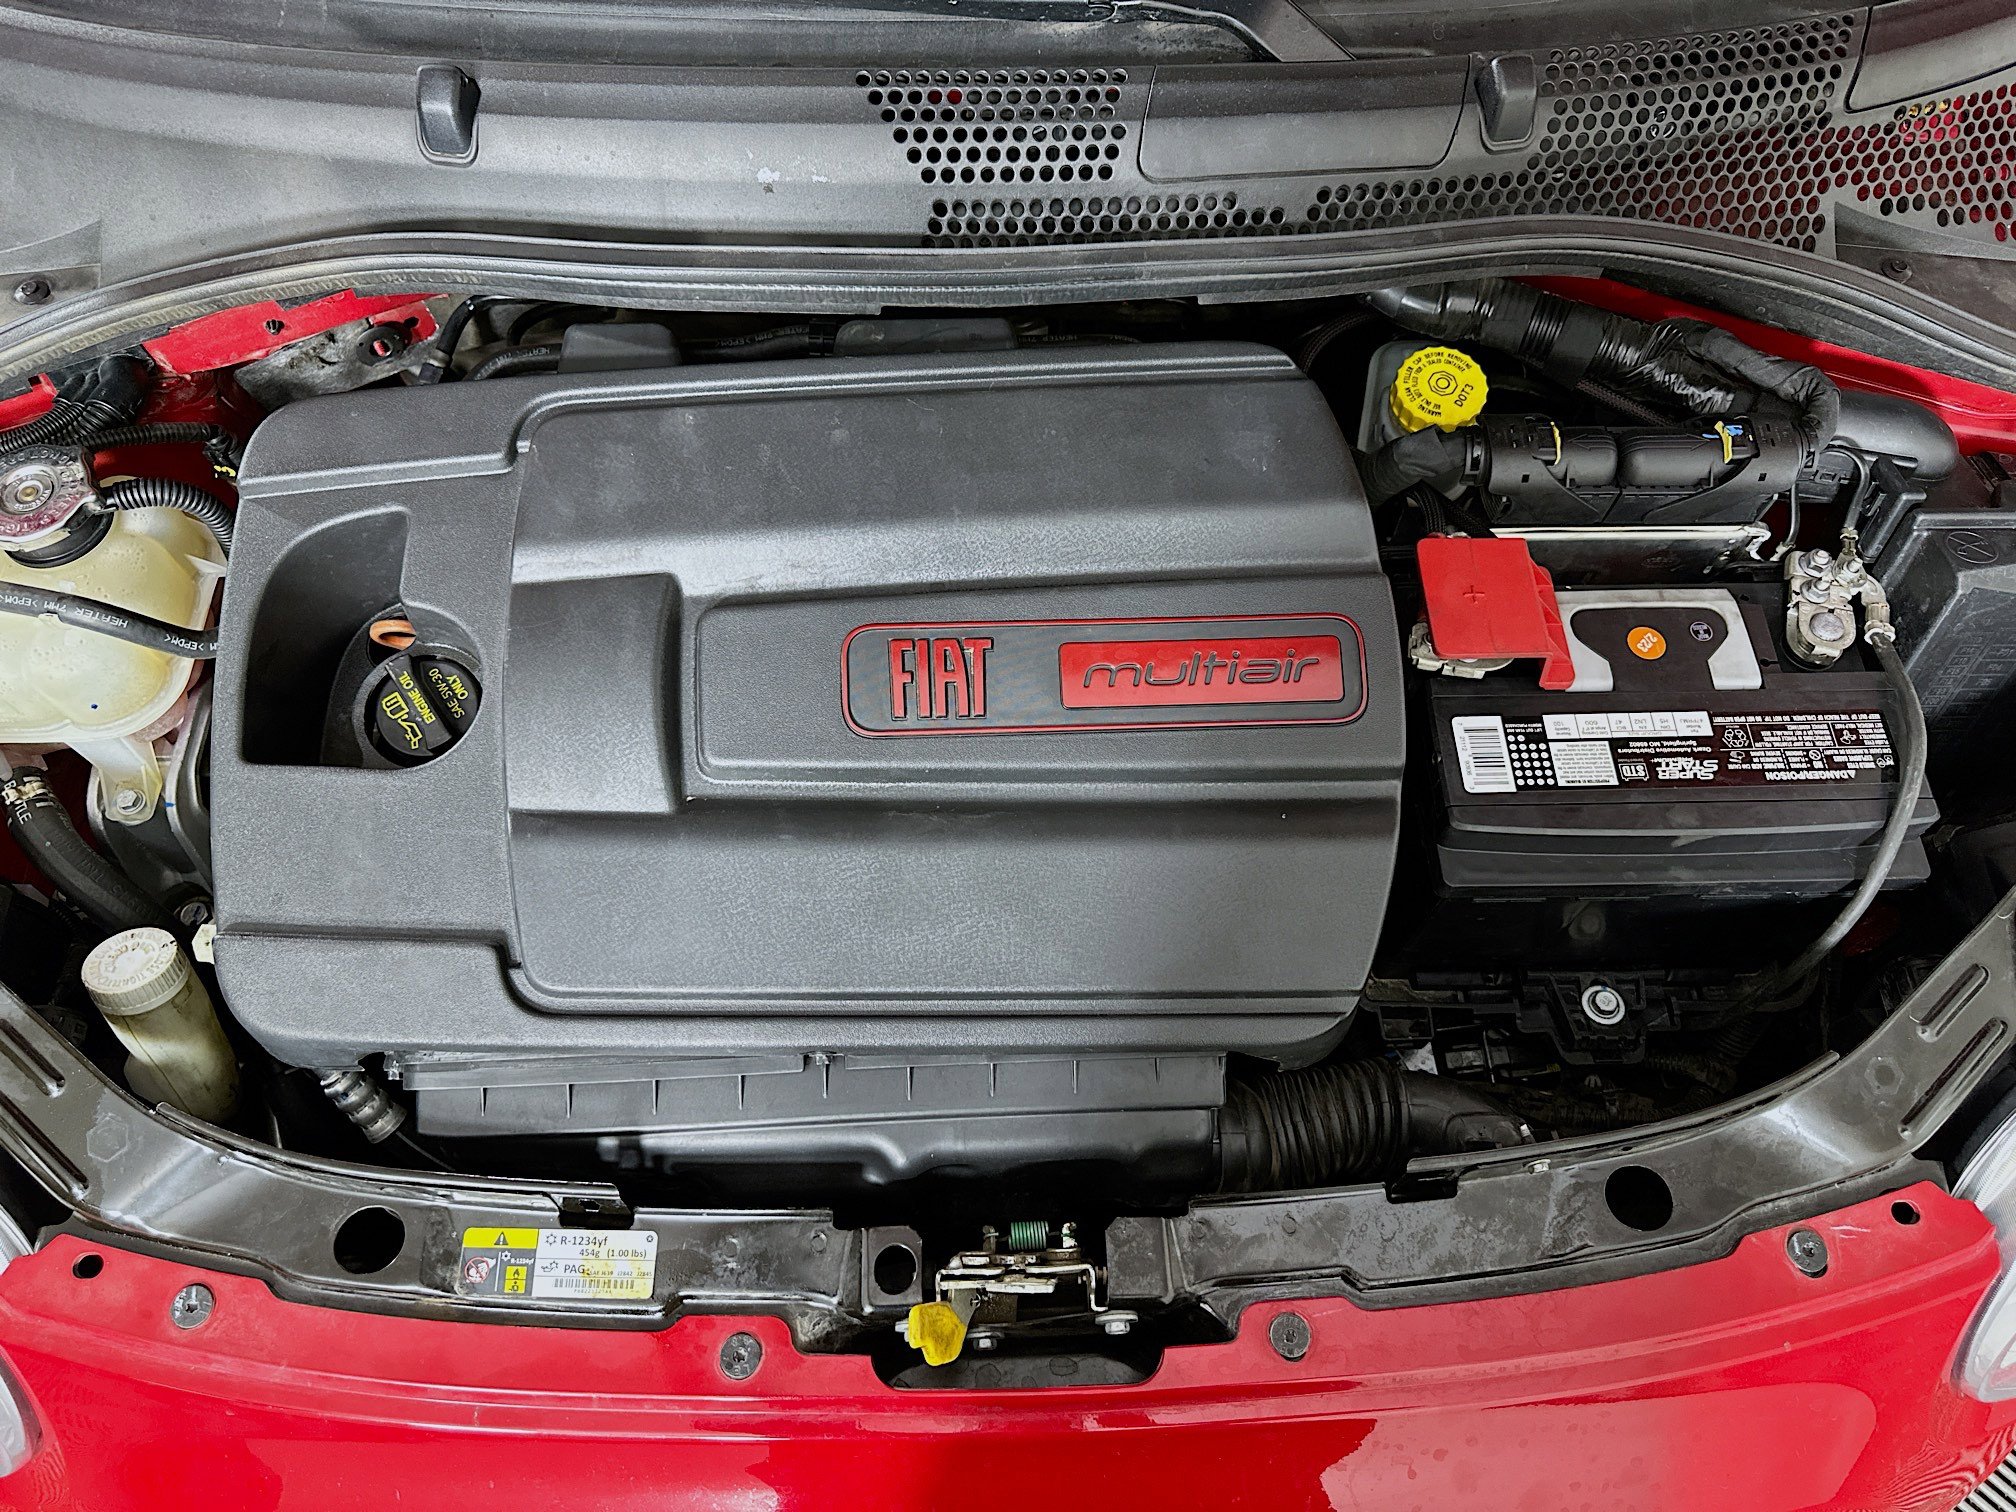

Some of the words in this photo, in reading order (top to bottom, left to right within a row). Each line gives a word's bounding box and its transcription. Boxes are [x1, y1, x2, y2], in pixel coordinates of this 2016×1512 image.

[1448, 353, 1472, 369] REMOVING
[1404, 367, 1413, 383] FILLER
[1405, 387, 1416, 402] CLEAN
[75, 606, 129, 629] HEATER
[1636, 632, 1658, 653] 2/23
[1083, 649, 1319, 689] multiair
[398, 671, 414, 690] OIL
[428, 667, 453, 700] 5W-30
[889, 637, 994, 719] FIAT
[446, 674, 469, 700] ONLY
[408, 688, 436, 725] ENGINE
[447, 698, 465, 719] SAE
[1622, 765, 1645, 776] STD
[1656, 760, 1718, 771] START
[1658, 770, 1713, 779] SUPER
[1765, 770, 1849, 780] DANGER/POISON
[560, 1236, 608, 1248] R-1234yf
[579, 1249, 601, 1258] 454g
[607, 1249, 629, 1258] (1.00
[632, 1249, 647, 1259] lbs)
